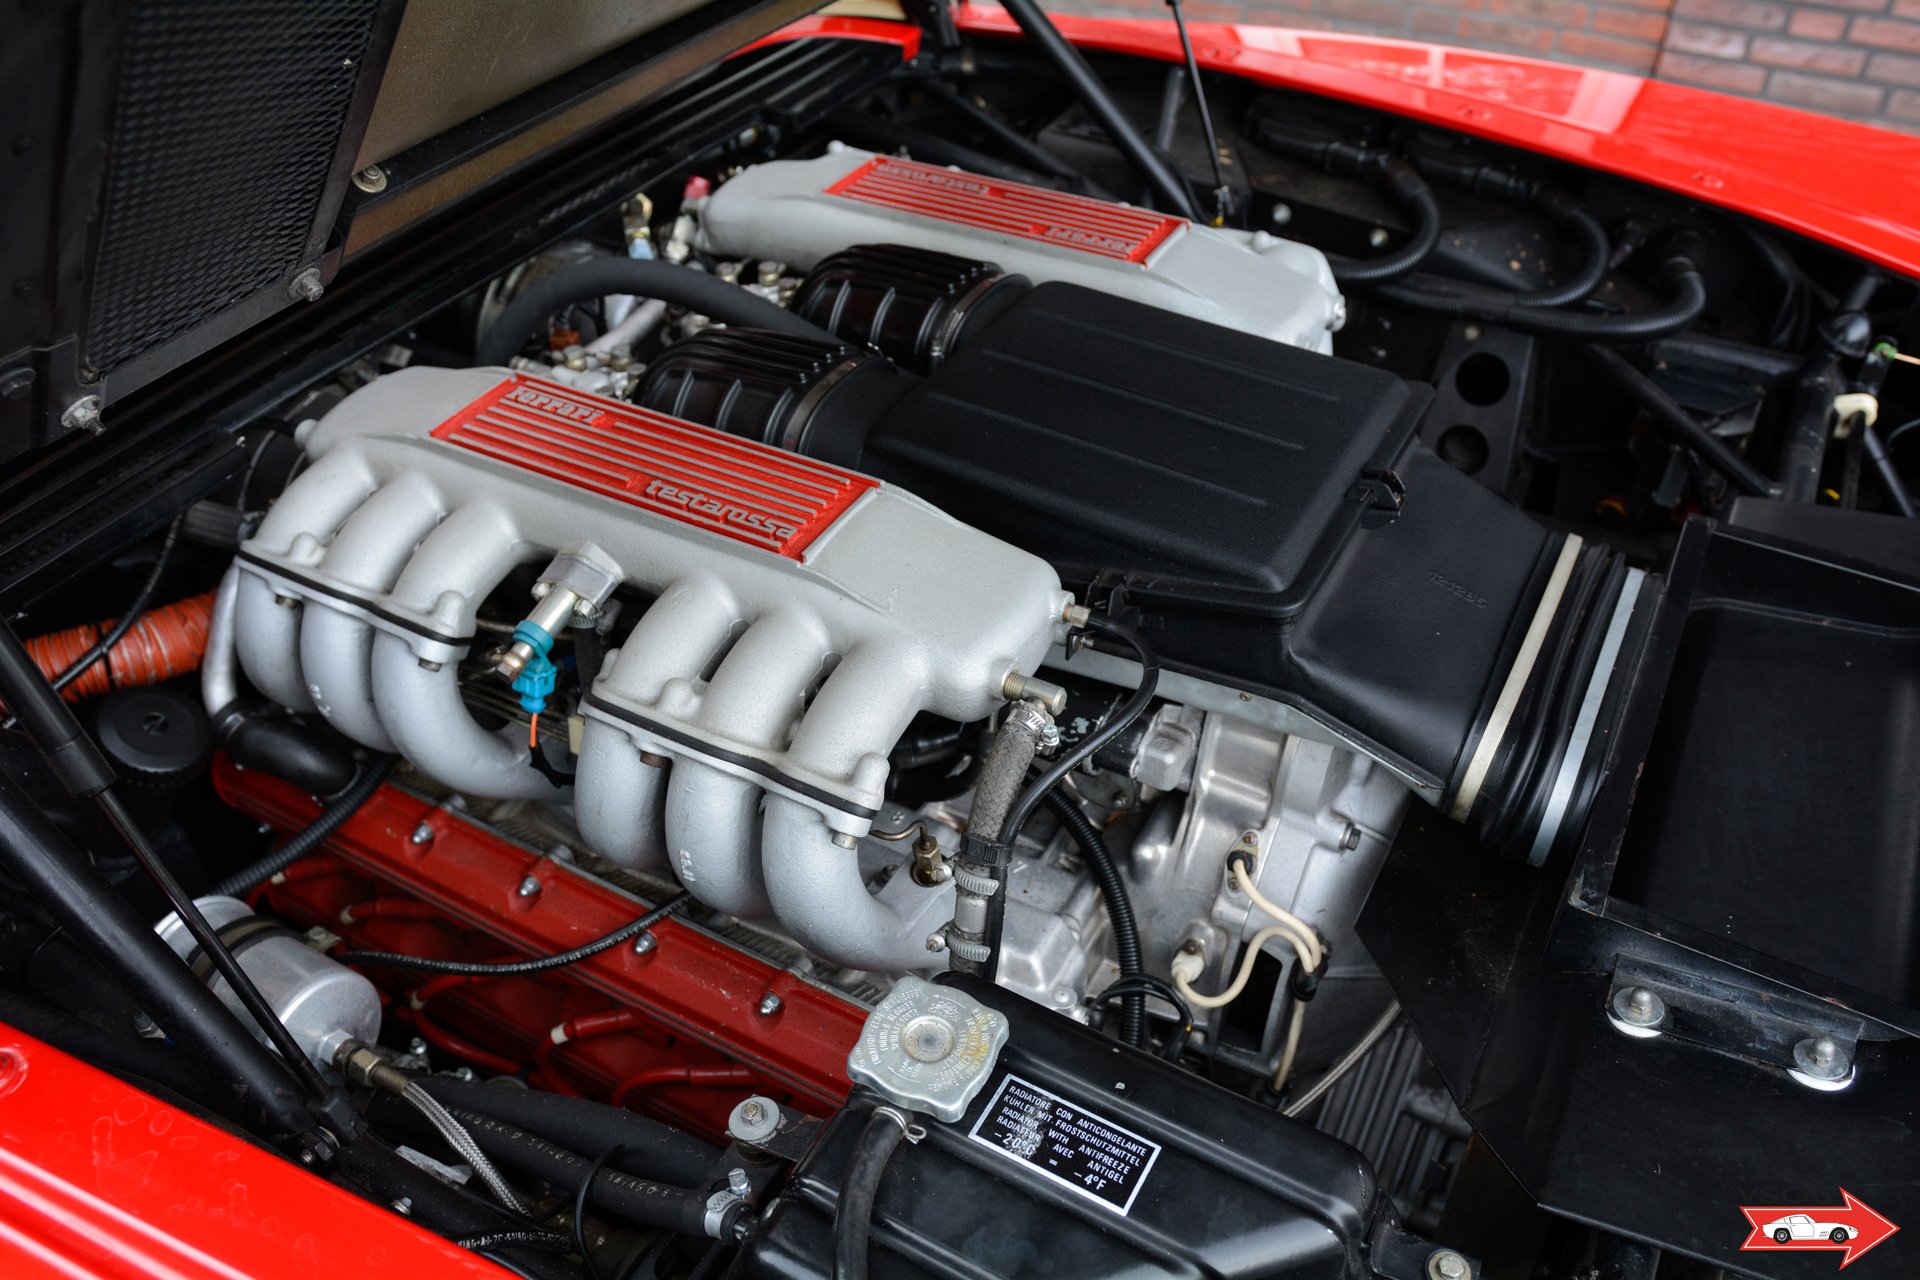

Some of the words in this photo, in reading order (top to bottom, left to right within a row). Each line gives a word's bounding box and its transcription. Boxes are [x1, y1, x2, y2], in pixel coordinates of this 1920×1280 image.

[646, 479, 797, 538] testarossa
[996, 1115, 1041, 1142] RADIATEUR
[1052, 1143, 1075, 1159] AVEC
[1086, 1160, 1124, 1185] ANTIGEL
[1001, 1106, 1040, 1130] RADIATOR
[1048, 1128, 1070, 1145] WITH
[1078, 1144, 1131, 1175] ANTIFREEZE
[1008, 1085, 1052, 1111] RADIATORE
[1055, 1107, 1074, 1121] CON
[1076, 1118, 1148, 1157] ANTICONGELANTE
[1055, 1119, 1140, 1167] FROSTSCHUTZMITTEL
